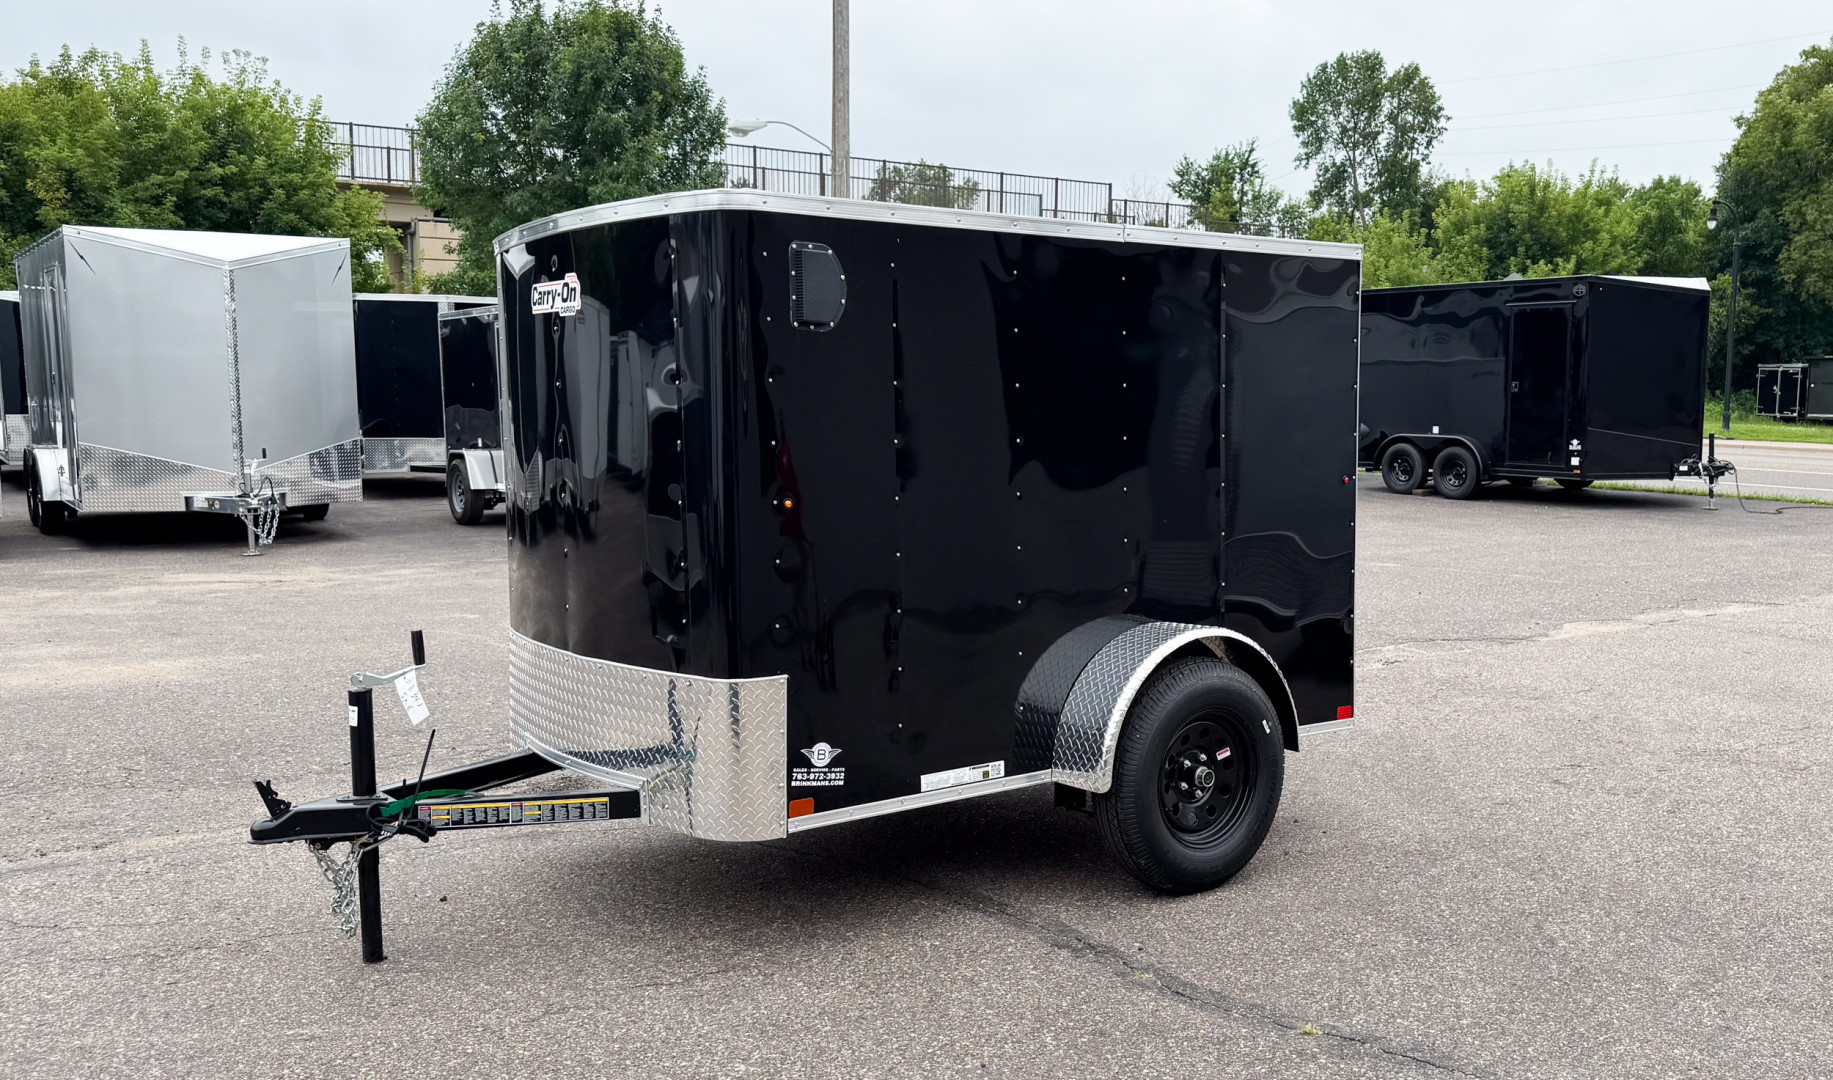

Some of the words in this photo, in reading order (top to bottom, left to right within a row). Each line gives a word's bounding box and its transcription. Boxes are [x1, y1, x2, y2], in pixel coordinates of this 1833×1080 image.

[532, 282, 577, 310] Carry-On
[560, 305, 576, 315] CARGO
[817, 749, 826, 760] B
[792, 772, 845, 780] 763-972-3932
